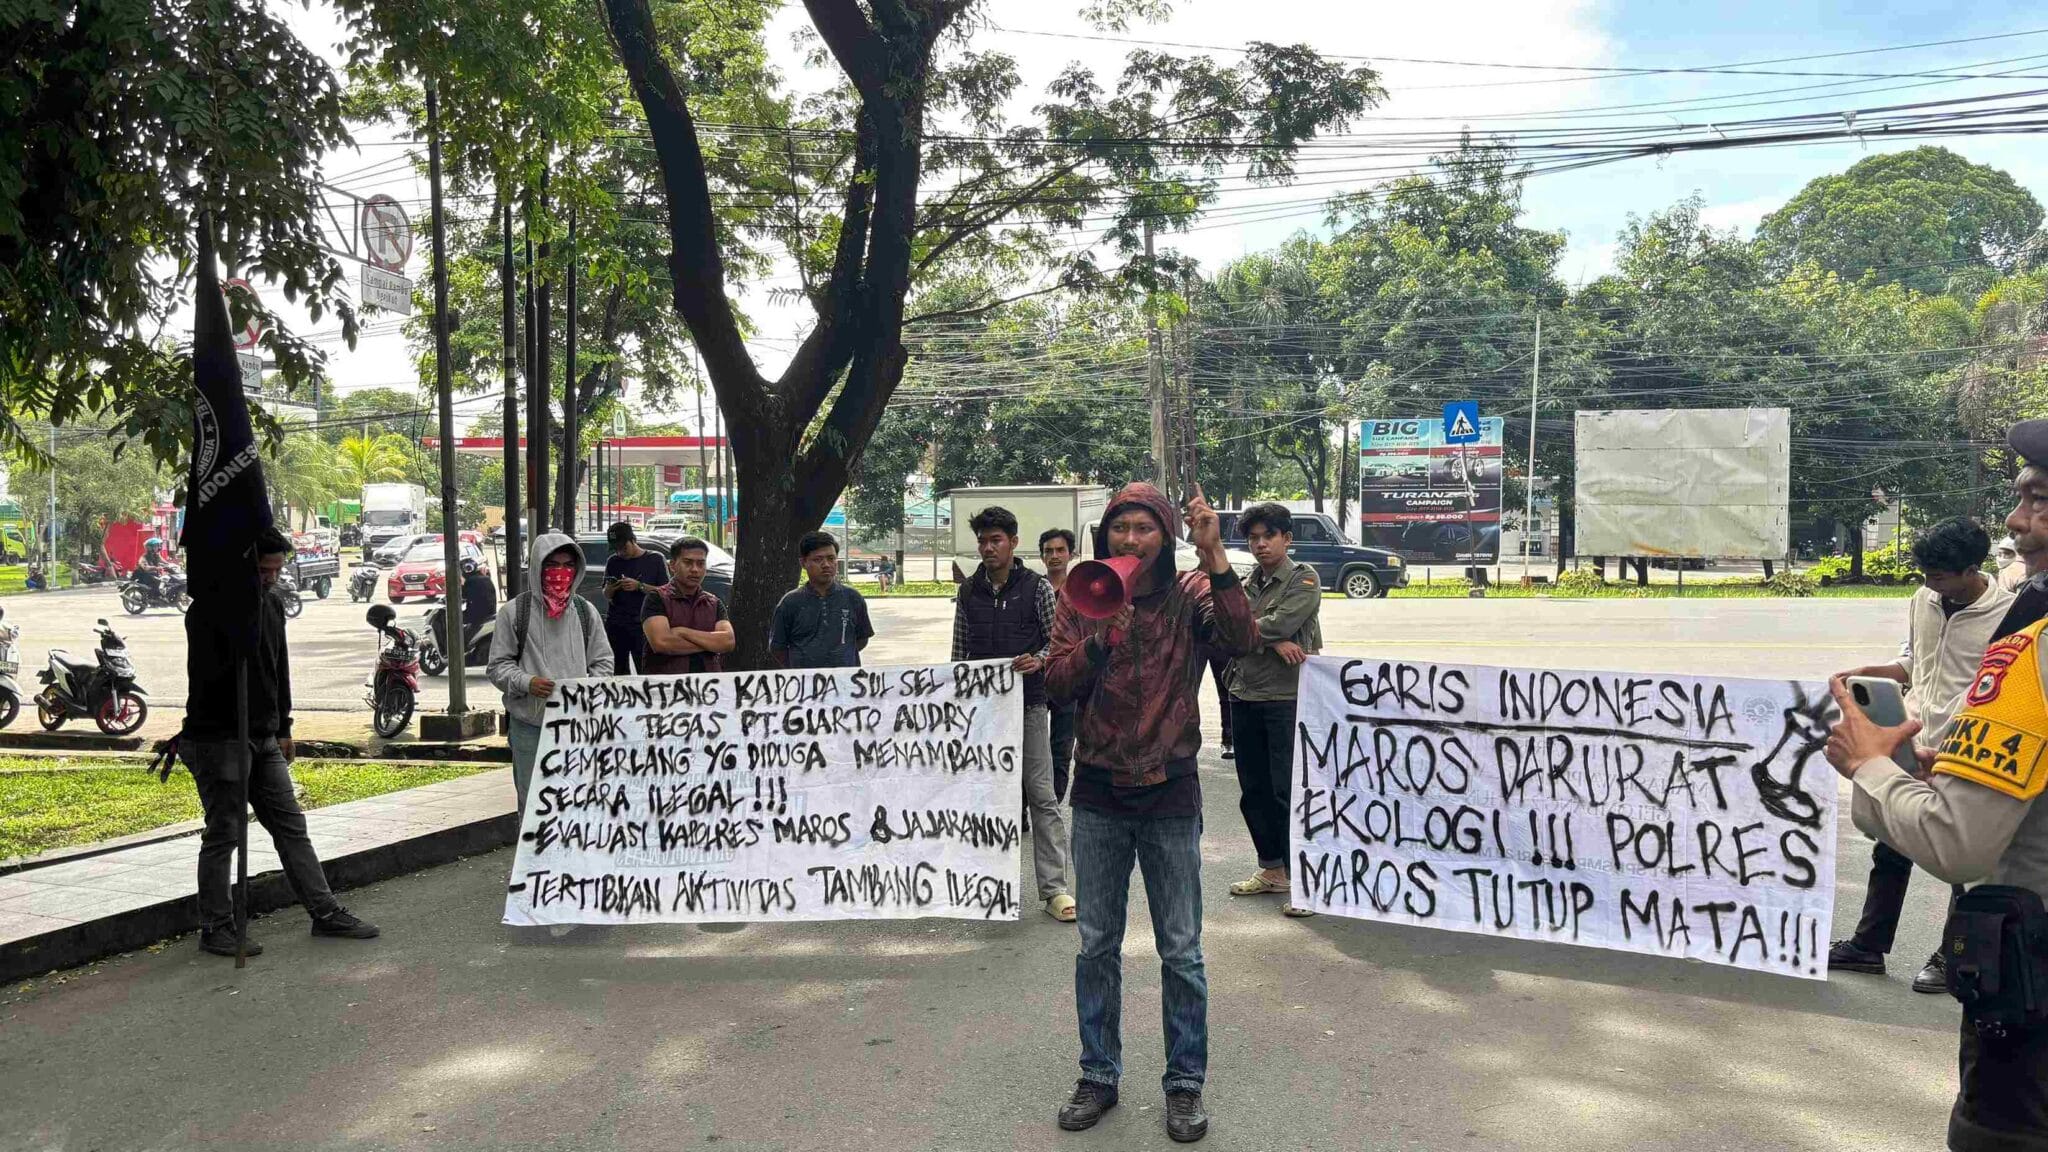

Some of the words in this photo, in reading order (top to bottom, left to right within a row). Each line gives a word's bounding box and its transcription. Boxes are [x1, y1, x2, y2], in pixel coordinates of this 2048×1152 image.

[1372, 421, 1419, 436] BIG
[734, 674, 839, 708] KAPOLDA
[851, 669, 893, 699] SUL
[899, 668, 944, 698] SEL
[953, 663, 1015, 699] BARU
[1340, 660, 1470, 714] GARIS
[1499, 669, 1736, 739] INDONESIA
[546, 714, 627, 744] TINDAK
[636, 711, 727, 743] TEGAS
[894, 702, 977, 740] AUDRY
[2001, 733, 2023, 756] 4
[540, 745, 693, 783] CEMERLANG
[705, 742, 738, 773] YG
[747, 743, 826, 773] DIDUGA
[854, 738, 1015, 773] MENAMBANG
[1298, 721, 1478, 796] MAROS
[1494, 734, 1736, 810] DARURAT
[535, 782, 630, 817] SECARA
[650, 780, 744, 817] ILEGAL
[659, 817, 764, 852] KAPOLRES
[772, 812, 851, 847] MAROS
[1296, 788, 1506, 858] EKOLOGI
[1606, 812, 1820, 888] POLRES
[673, 870, 796, 913] AKTIVITAS
[807, 862, 937, 907] TAMBANG
[946, 868, 1019, 919] ILEGAL
[1299, 849, 1437, 917] MAROS
[1452, 868, 1595, 941] TUTUP
